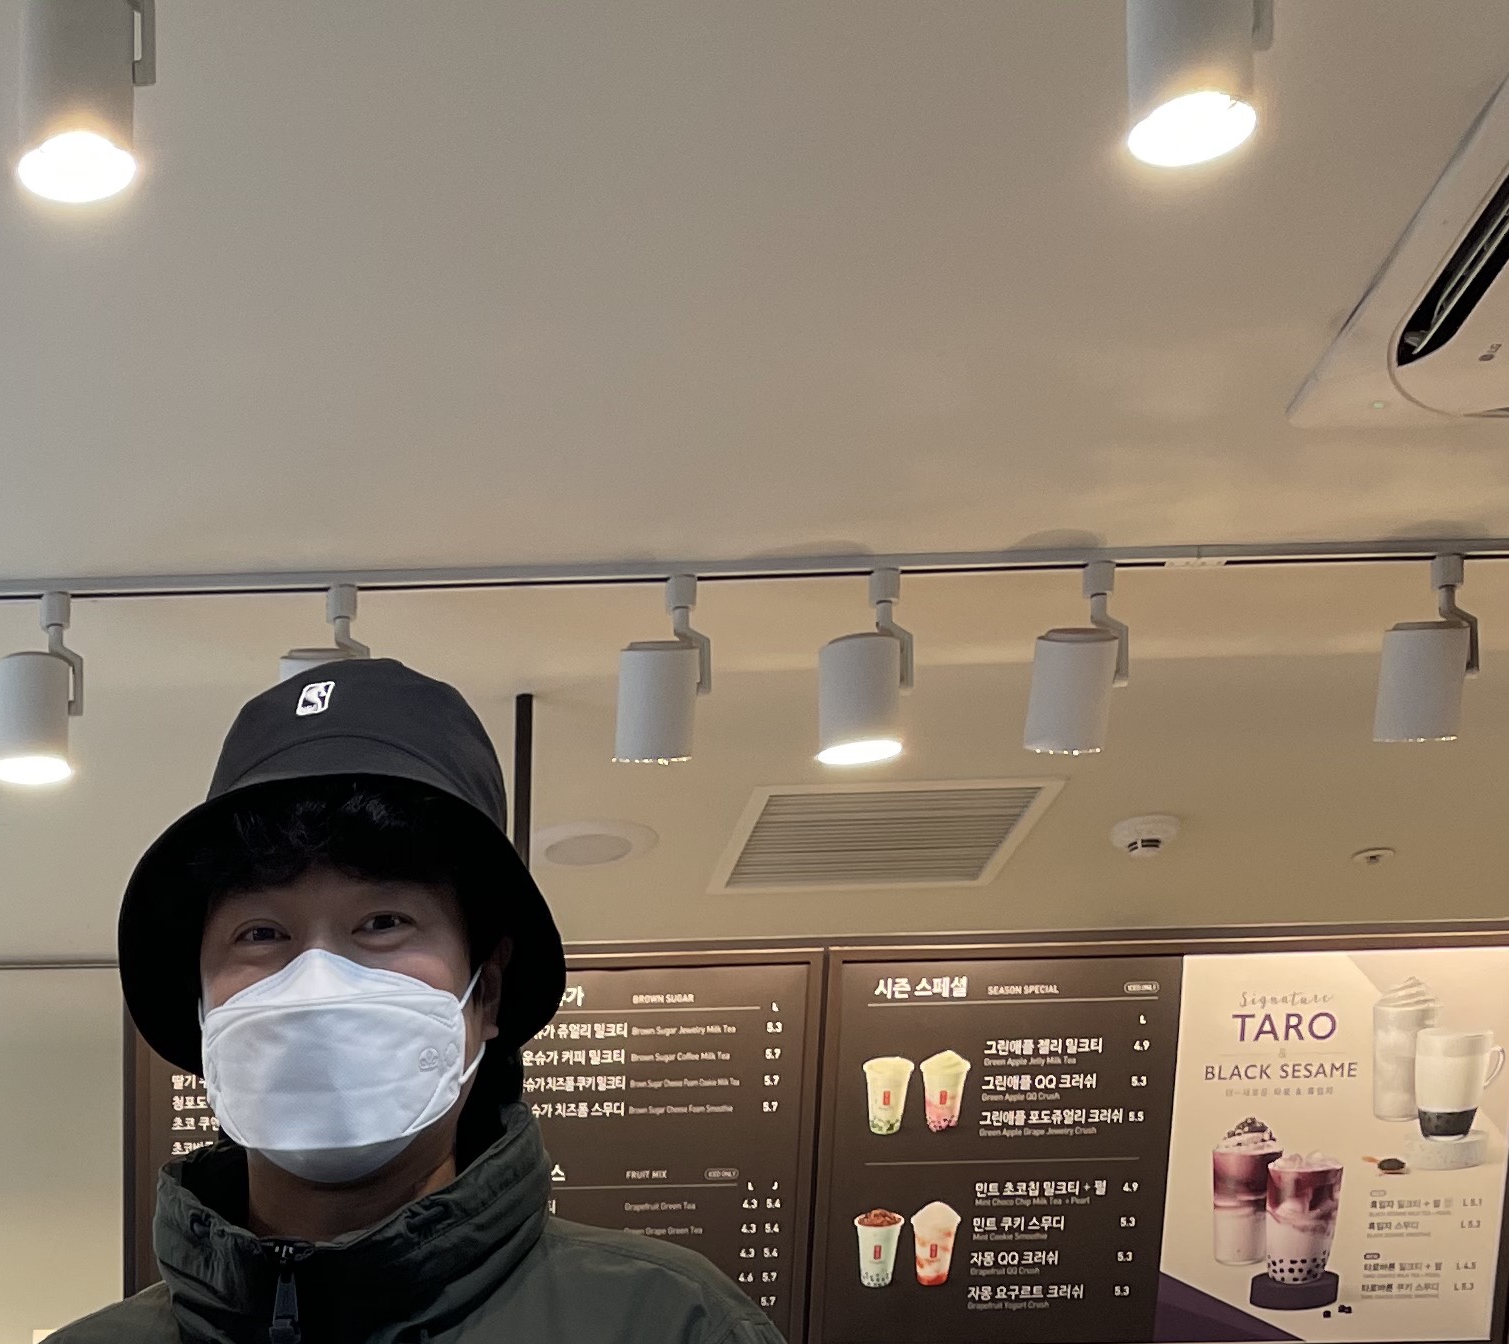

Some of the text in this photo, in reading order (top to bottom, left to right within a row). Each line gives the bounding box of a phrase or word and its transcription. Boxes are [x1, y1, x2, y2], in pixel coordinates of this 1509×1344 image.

[874, 976, 968, 999] 시즌 스페셜
[988, 984, 1059, 995] SEASON SPECIAL
[633, 993, 694, 1004] BROWN SUGAR
[557, 1022, 627, 1039] 쥬얼리 밀크티
[632, 1026, 654, 1036] Brown
[656, 1026, 677, 1037] Sugar
[707, 1024, 721, 1034] Milk
[723, 1024, 737, 1034] Tea
[767, 1022, 782, 1033] 5.3
[1232, 1012, 1337, 1042] TARO
[984, 1037, 1103, 1055] 그린애플 젤리 밀크티
[1133, 1040, 1150, 1051] 4.9
[561, 1049, 586, 1065] 커피
[589, 1049, 625, 1065] 밀크티
[631, 1053, 654, 1062] Brown
[655, 1052, 675, 1064] Sugar
[701, 1052, 715, 1061] Milk
[717, 1052, 731, 1061] Tea
[765, 1049, 781, 1060] 5.7
[1205, 1062, 1358, 1081] BLACK SESAME
[171, 1074, 197, 1090] 딸기
[597, 1075, 626, 1091] 밀크티
[764, 1075, 780, 1086] 5.7
[982, 1074, 1097, 1091] 그린애플 QQ 크러쉬
[1131, 1075, 1147, 1088] 5.3
[172, 1096, 209, 1111] 청포도
[555, 1102, 625, 1118] 치즈폼 스무디
[762, 1101, 778, 1113] 5.7
[979, 1110, 1025, 1126] 그린애플
[1087, 1107, 1124, 1124] 크러쉬
[171, 1117, 196, 1131] 초코
[626, 1169, 667, 1180] FRUIT MIX
[975, 1181, 1000, 1198] 민트
[1043, 1180, 1080, 1196] 밀크티
[1122, 1182, 1139, 1193] 4.9
[660, 1202, 682, 1212] Green
[683, 1202, 696, 1211] Tea
[742, 1198, 781, 1209] 4.3 5.4
[973, 1215, 1065, 1232] 민트 쿠키 스무디
[1120, 1217, 1136, 1227] 5.3
[741, 1224, 756, 1234] 4.3
[998, 1252, 1019, 1266] QQ
[1021, 1250, 1059, 1265] 크러쉬
[1117, 1252, 1133, 1262] 5.3
[738, 1272, 777, 1283] 4.6 5.7
[995, 1285, 1044, 1300] 요구르트
[1046, 1284, 1084, 1300] 크러쉬
[1114, 1286, 1130, 1297] 5.3
